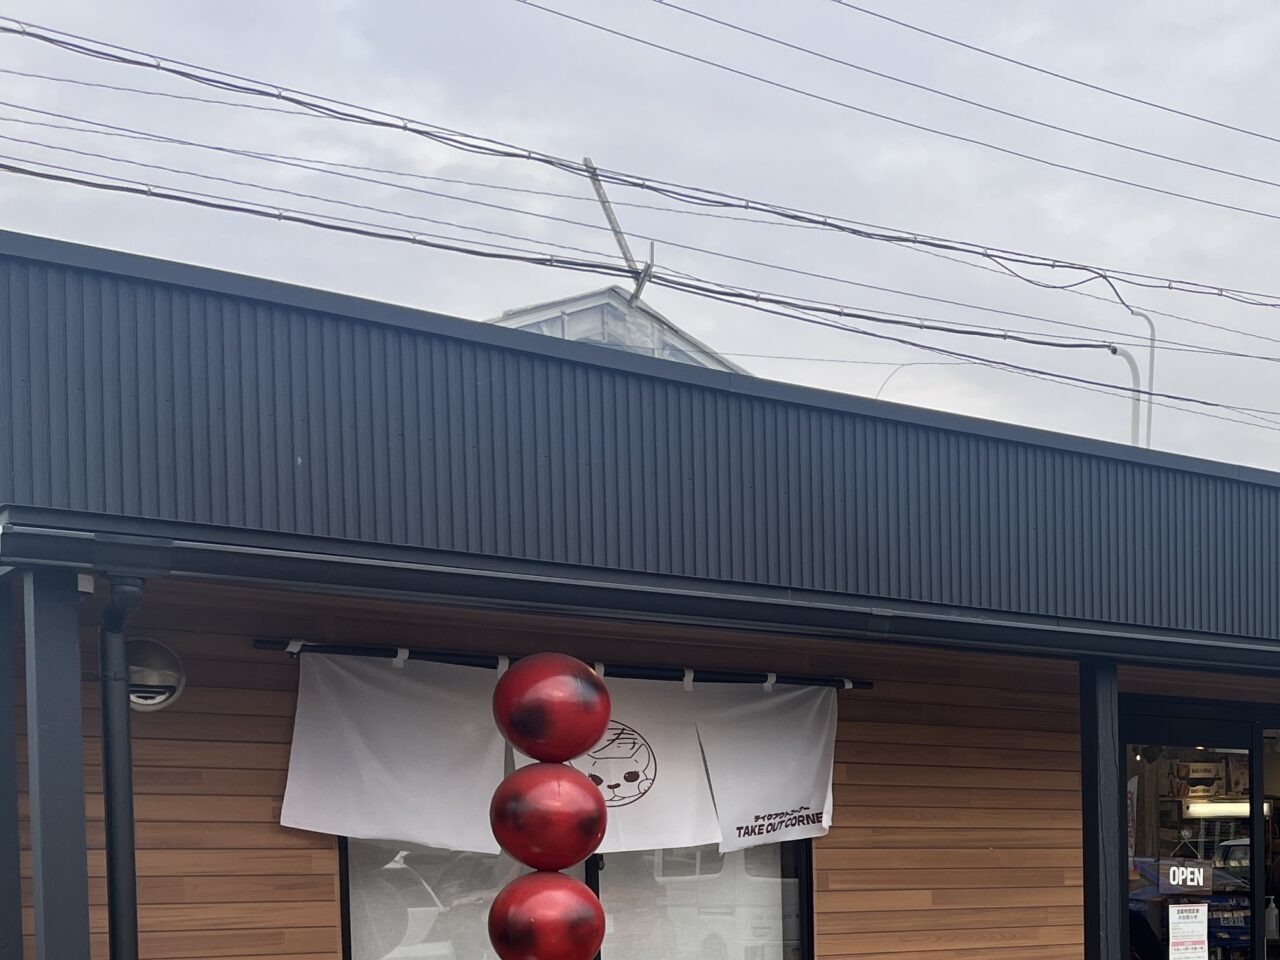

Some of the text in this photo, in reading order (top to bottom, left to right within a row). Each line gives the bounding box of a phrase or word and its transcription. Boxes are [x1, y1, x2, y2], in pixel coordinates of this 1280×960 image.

[736, 823, 764, 838] TAKE
[766, 819, 785, 834] OUT
[1169, 866, 1203, 886] OPEN
